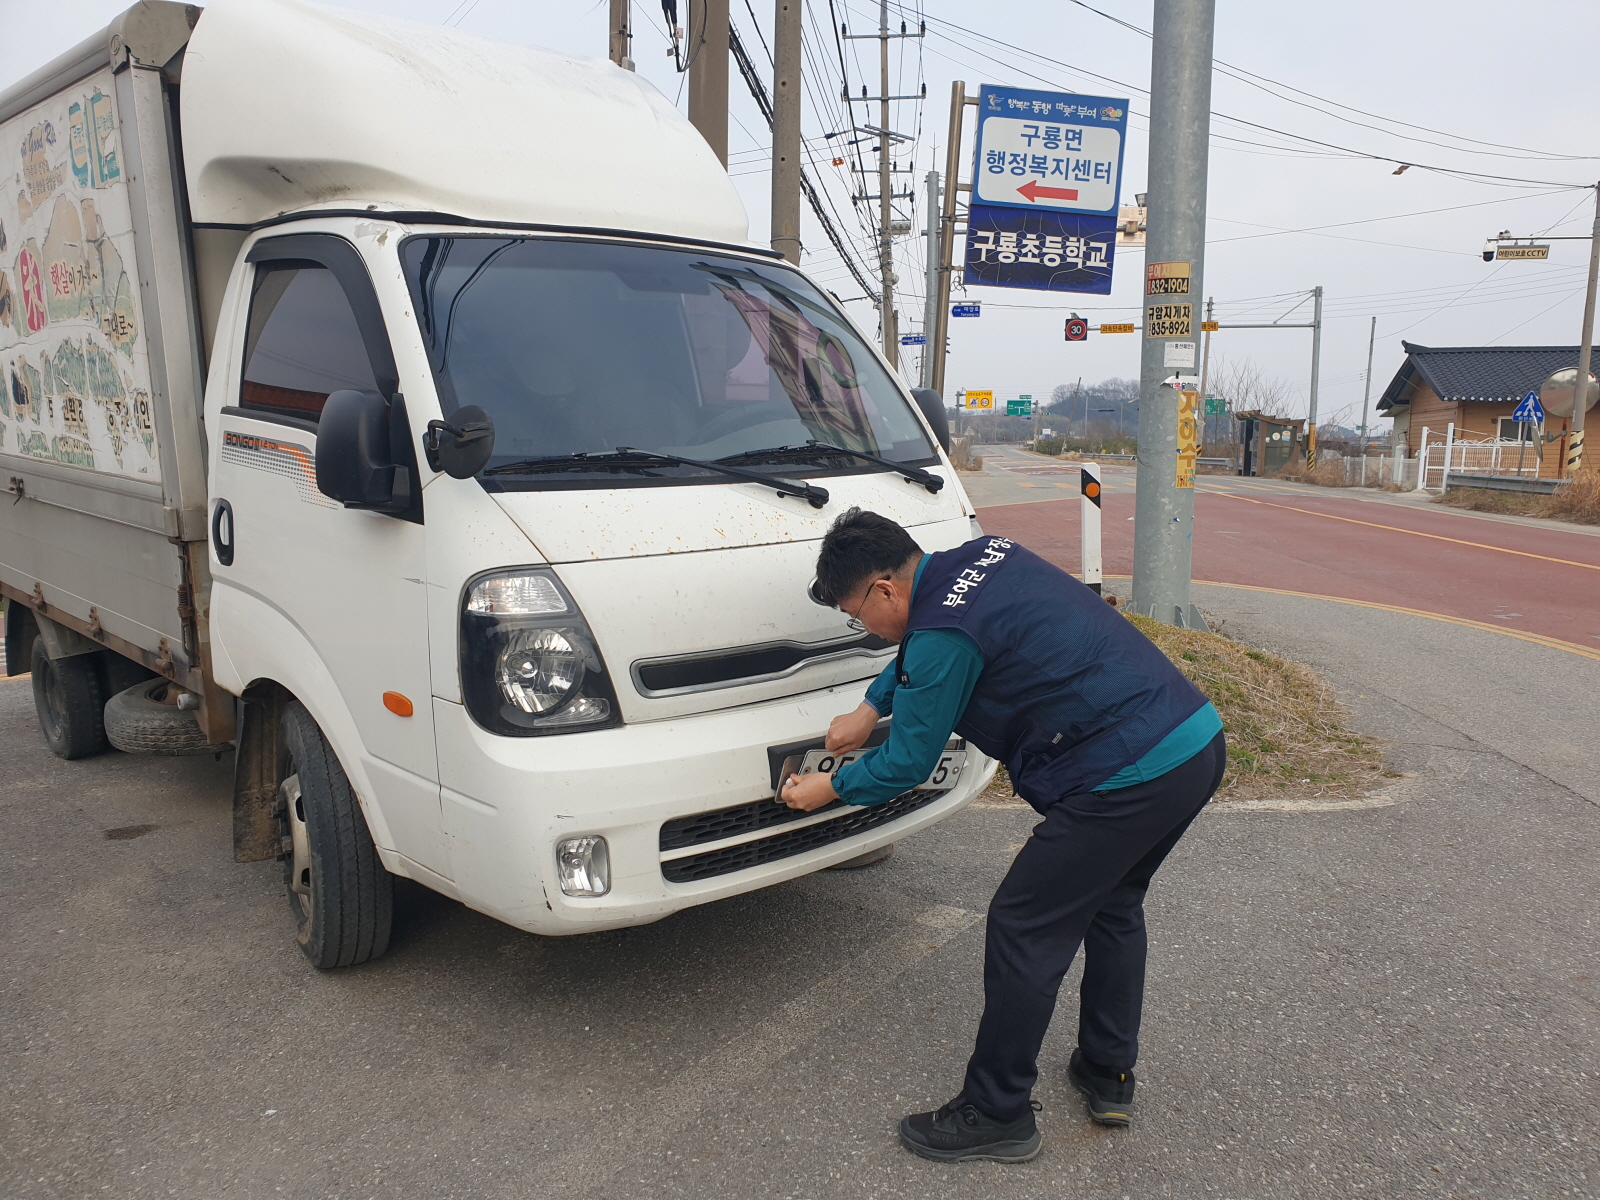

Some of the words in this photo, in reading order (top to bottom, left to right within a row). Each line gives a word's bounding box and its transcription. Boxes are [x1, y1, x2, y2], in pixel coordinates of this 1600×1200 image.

[1031, 101, 1052, 115] 동행
[1077, 105, 1097, 119] 부여
[1020, 124, 1083, 152] 구룡면
[986, 150, 1112, 185] 행정복지센터
[974, 230, 1107, 269] 구룡초등학교
[1148, 305, 1191, 321] 규암지게차
[1070, 325, 1082, 334] 30
[942, 568, 986, 608] 부여군
